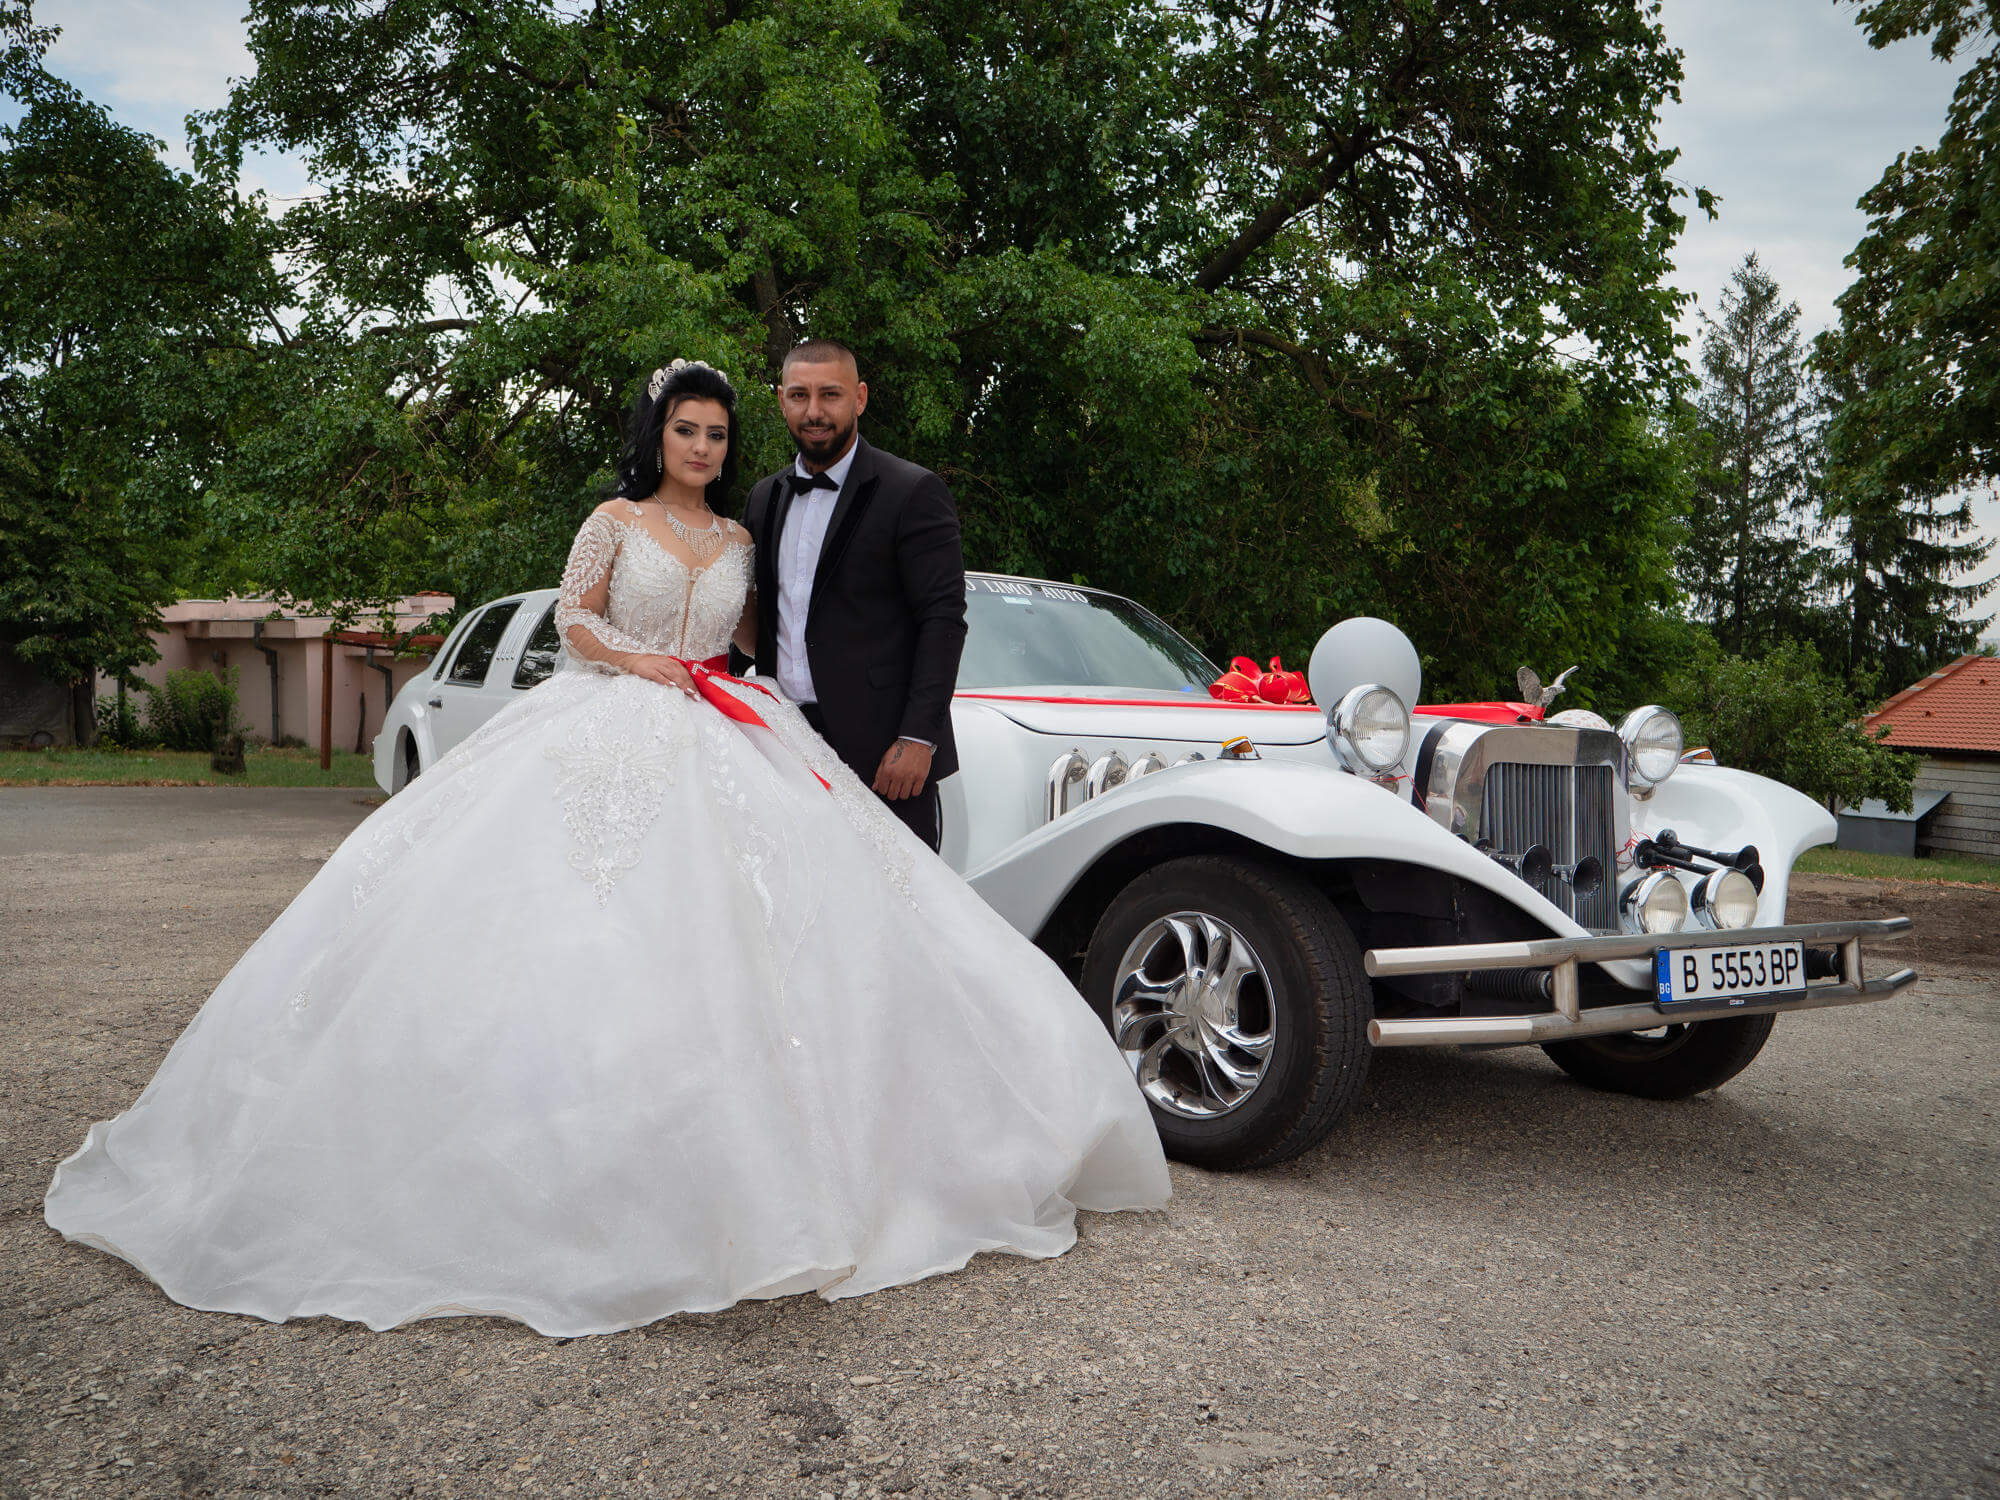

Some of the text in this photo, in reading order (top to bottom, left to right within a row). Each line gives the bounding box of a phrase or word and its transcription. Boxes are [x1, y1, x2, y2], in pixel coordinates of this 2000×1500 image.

[982, 580, 1033, 596] LIMO
[1040, 586, 1089, 604] AUTO
[1683, 955, 1699, 993] B
[1659, 982, 1671, 994] BG
